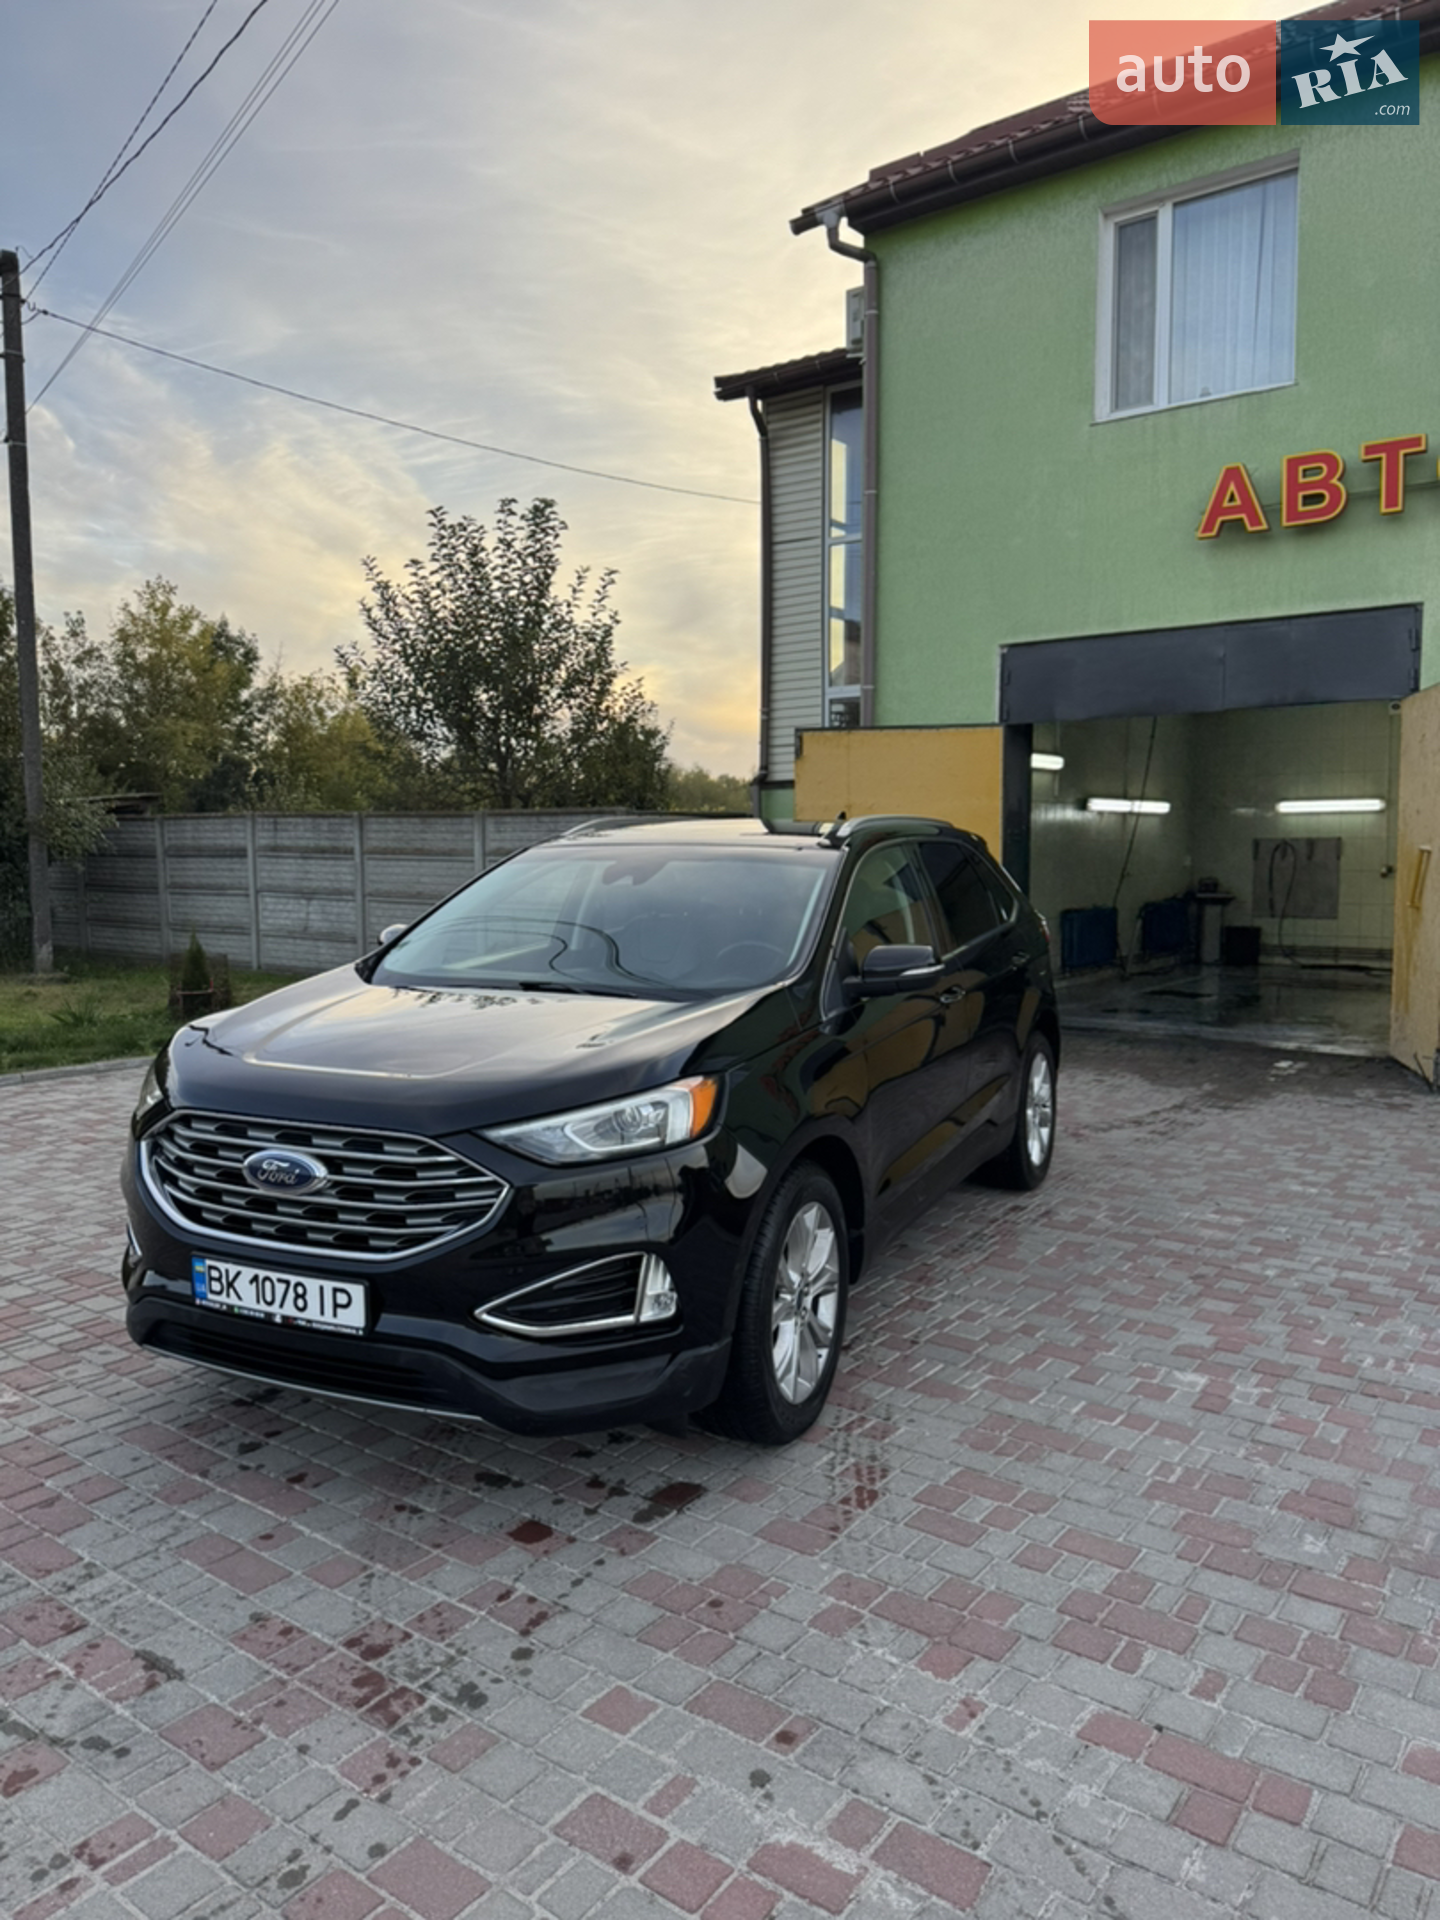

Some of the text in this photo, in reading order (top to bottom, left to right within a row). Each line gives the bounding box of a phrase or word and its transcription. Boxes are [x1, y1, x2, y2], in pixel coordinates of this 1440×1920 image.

[1196, 433, 1440, 539] АВТ
[257, 1159, 300, 1185] Ford
[207, 1265, 243, 1302] BK
[249, 1273, 308, 1314] 1078
[319, 1284, 353, 1319] IP
